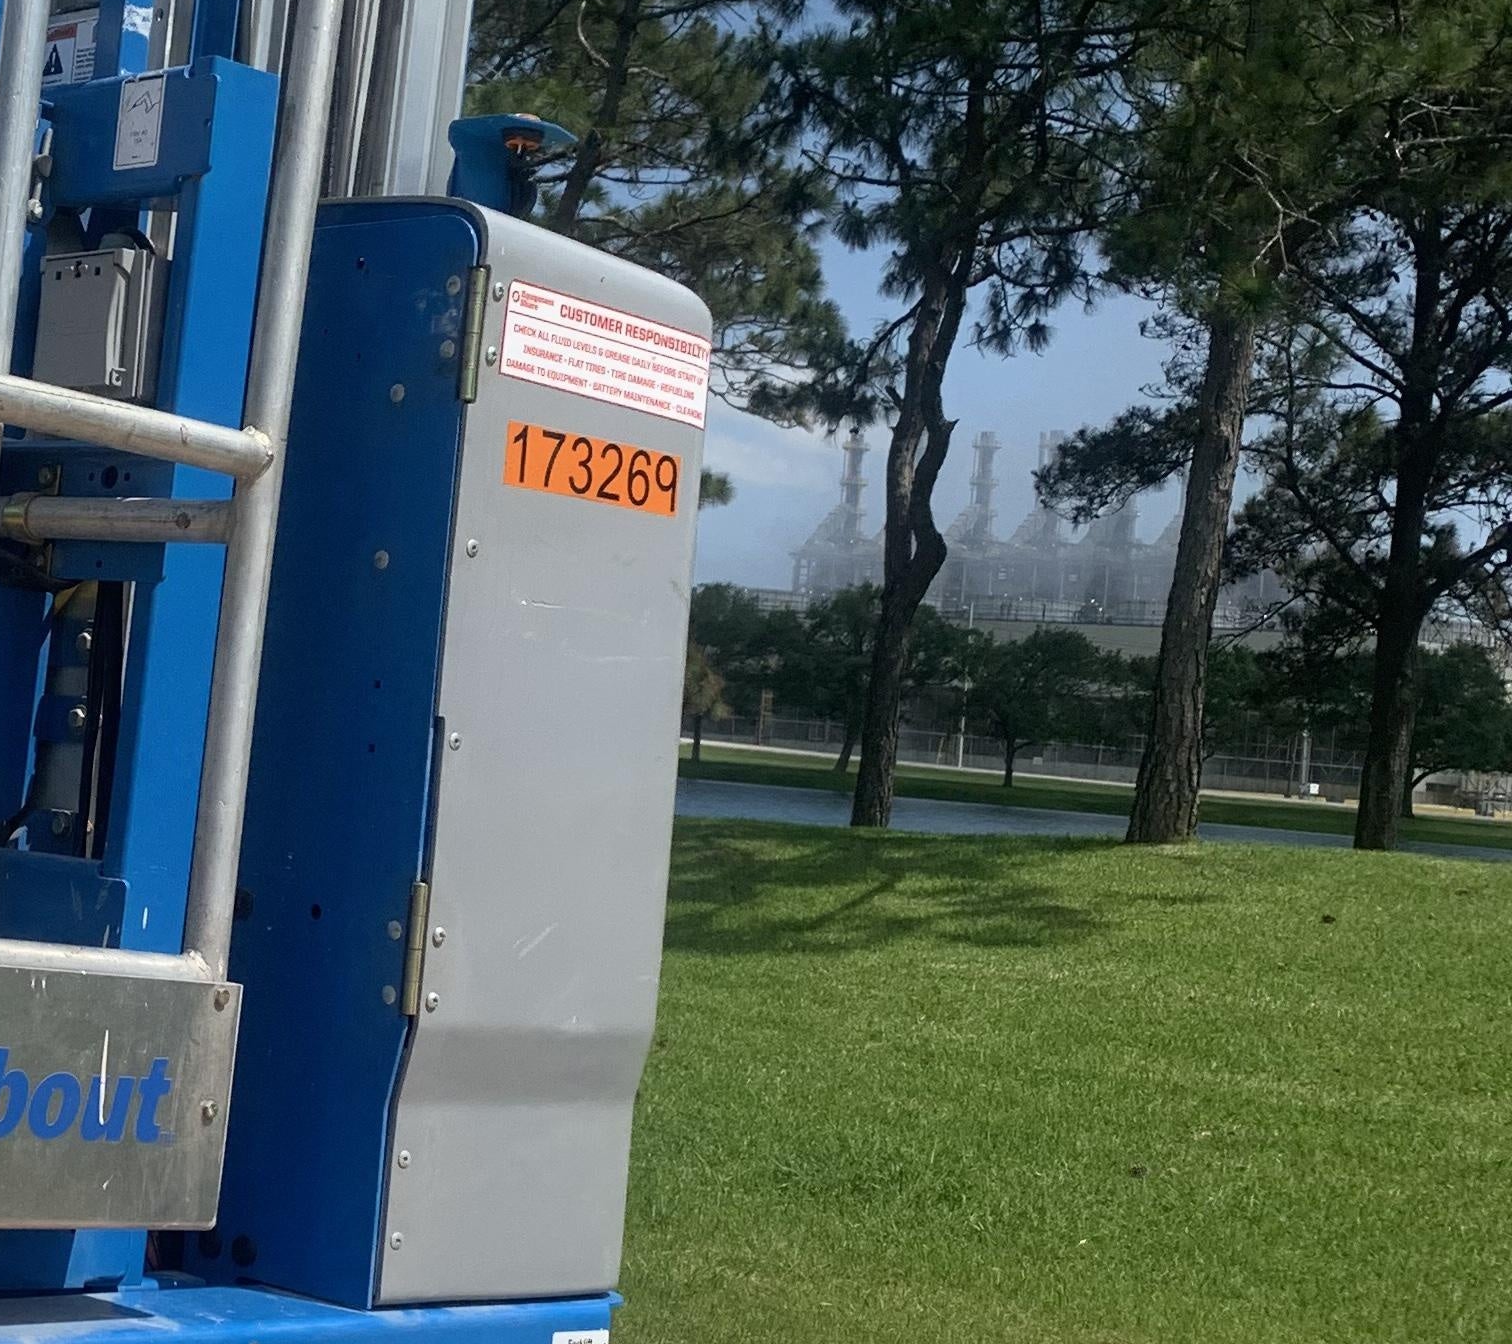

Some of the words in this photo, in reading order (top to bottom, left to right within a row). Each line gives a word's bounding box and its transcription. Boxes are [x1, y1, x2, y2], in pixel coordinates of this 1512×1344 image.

[513, 323, 536, 336] CHECK
[538, 330, 549, 342] ALL
[551, 334, 571, 347] FLUID
[573, 341, 597, 355] LEVELS
[605, 349, 630, 364] GREASE
[632, 356, 651, 370] DAILY
[652, 361, 676, 378] BEFORE
[677, 369, 696, 383] START
[560, 304, 622, 334] CUSTOMER
[625, 324, 709, 362] RESPONSIBILITY
[506, 358, 535, 374] DAMAGE
[537, 366, 546, 377] TO
[547, 369, 588, 388] EQUIPMENT
[593, 382, 622, 398] BATTERY
[623, 390, 671, 410] MAINTENANCE
[523, 344, 563, 363] INSURANCE
[569, 357, 584, 368] FLAT
[586, 361, 606, 374] TIRES
[611, 368, 627, 381] TIRE
[627, 372, 656, 390] DAMAGE
[660, 382, 695, 401] REFUELING
[513, 424, 678, 512] 173269
